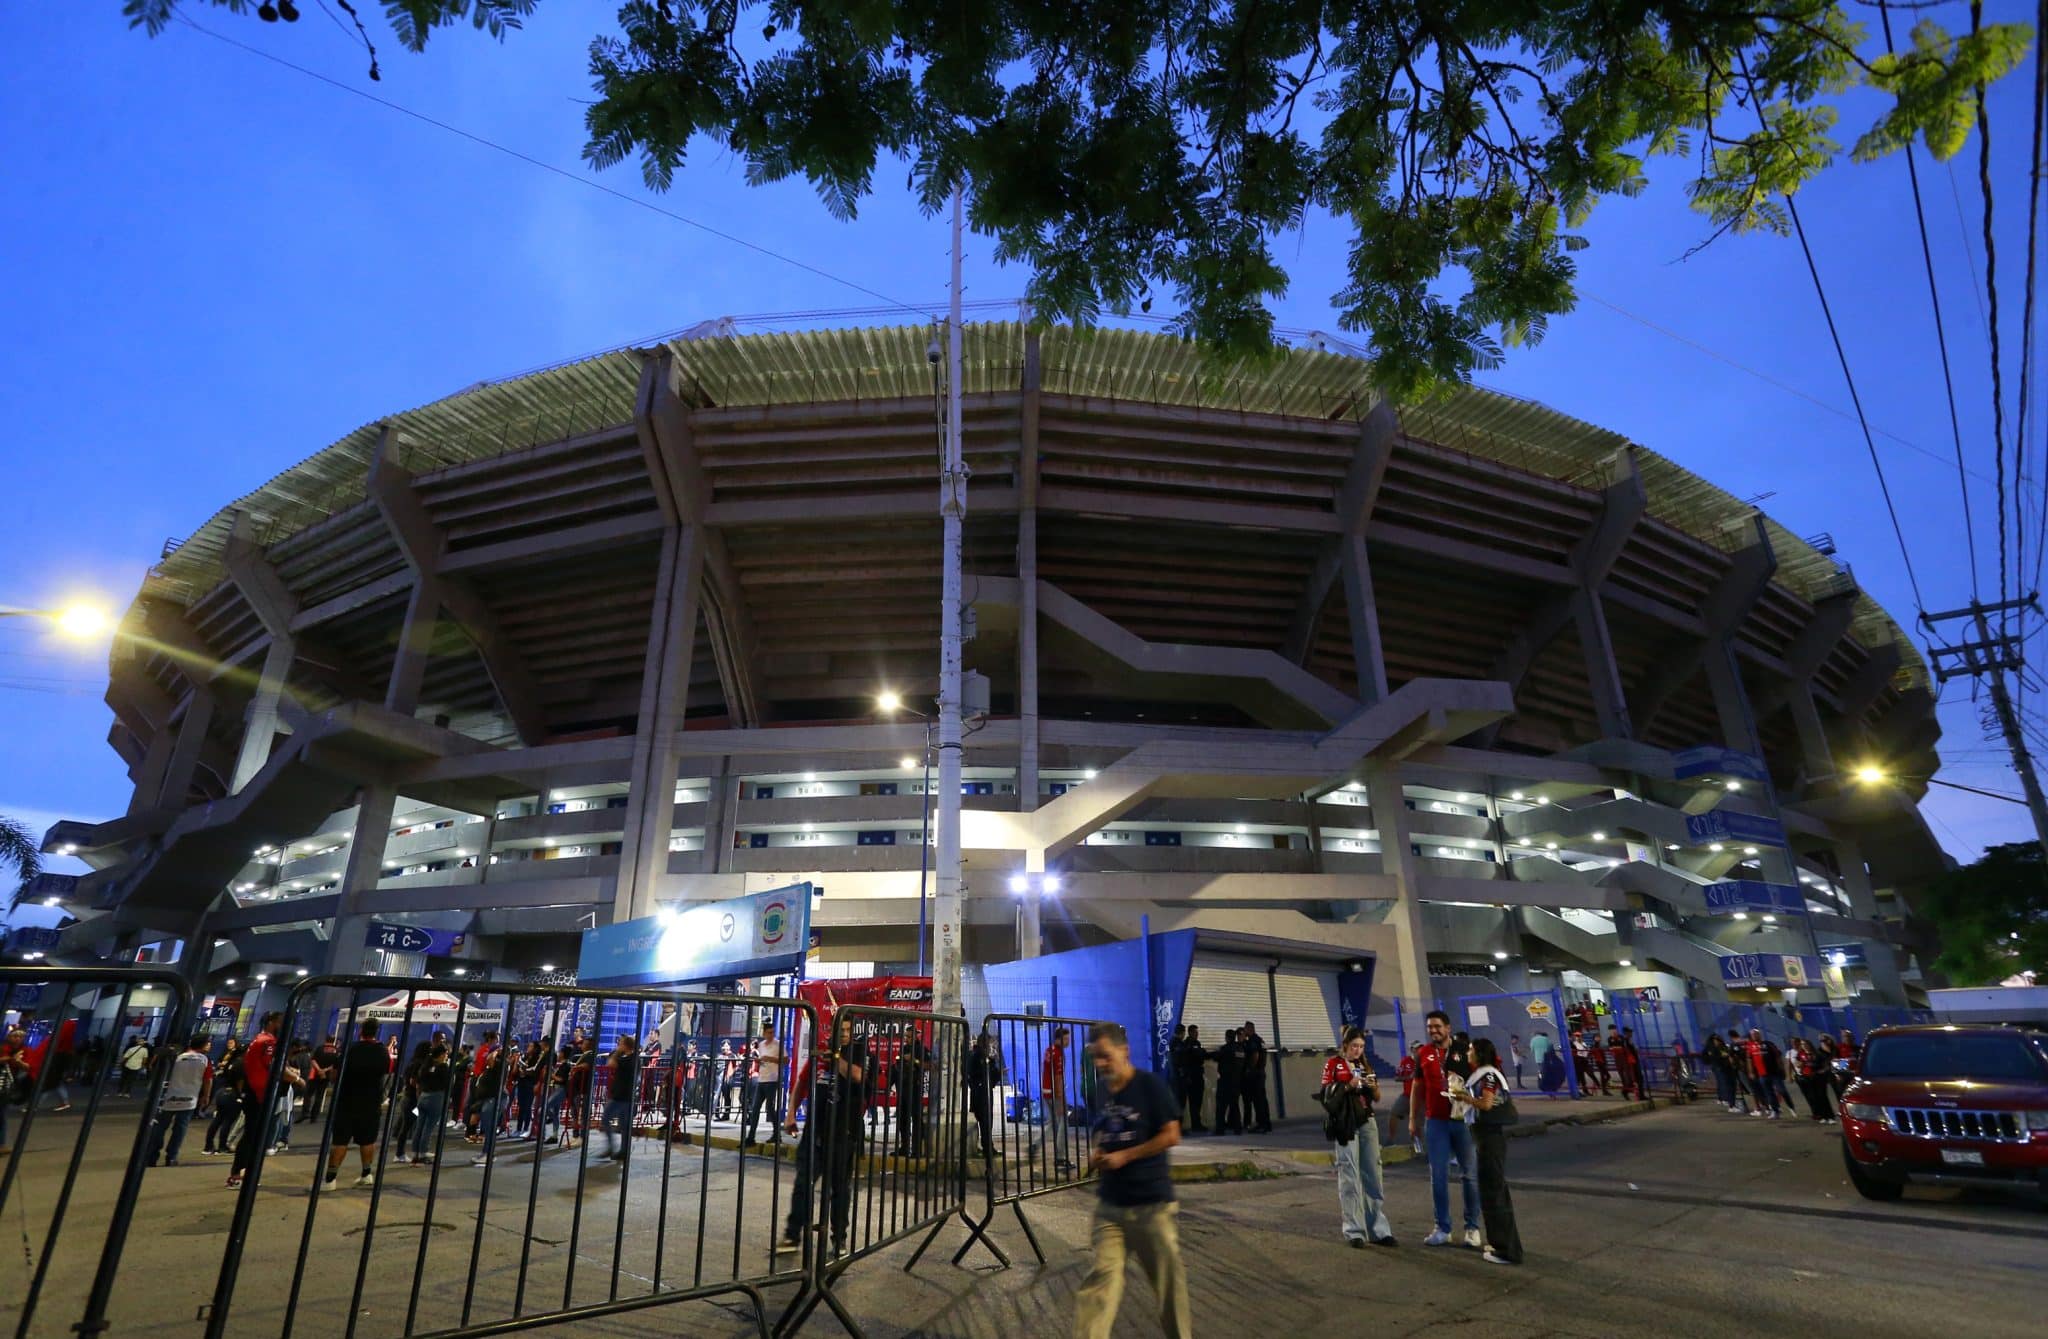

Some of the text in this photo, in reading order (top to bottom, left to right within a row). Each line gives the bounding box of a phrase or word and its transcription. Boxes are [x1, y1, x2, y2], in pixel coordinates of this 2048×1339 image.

[380, 932, 396, 945] 14
[402, 934, 411, 947] C
[217, 1006, 230, 1017] 12
[368, 1010, 405, 1018] ROJINEGRO
